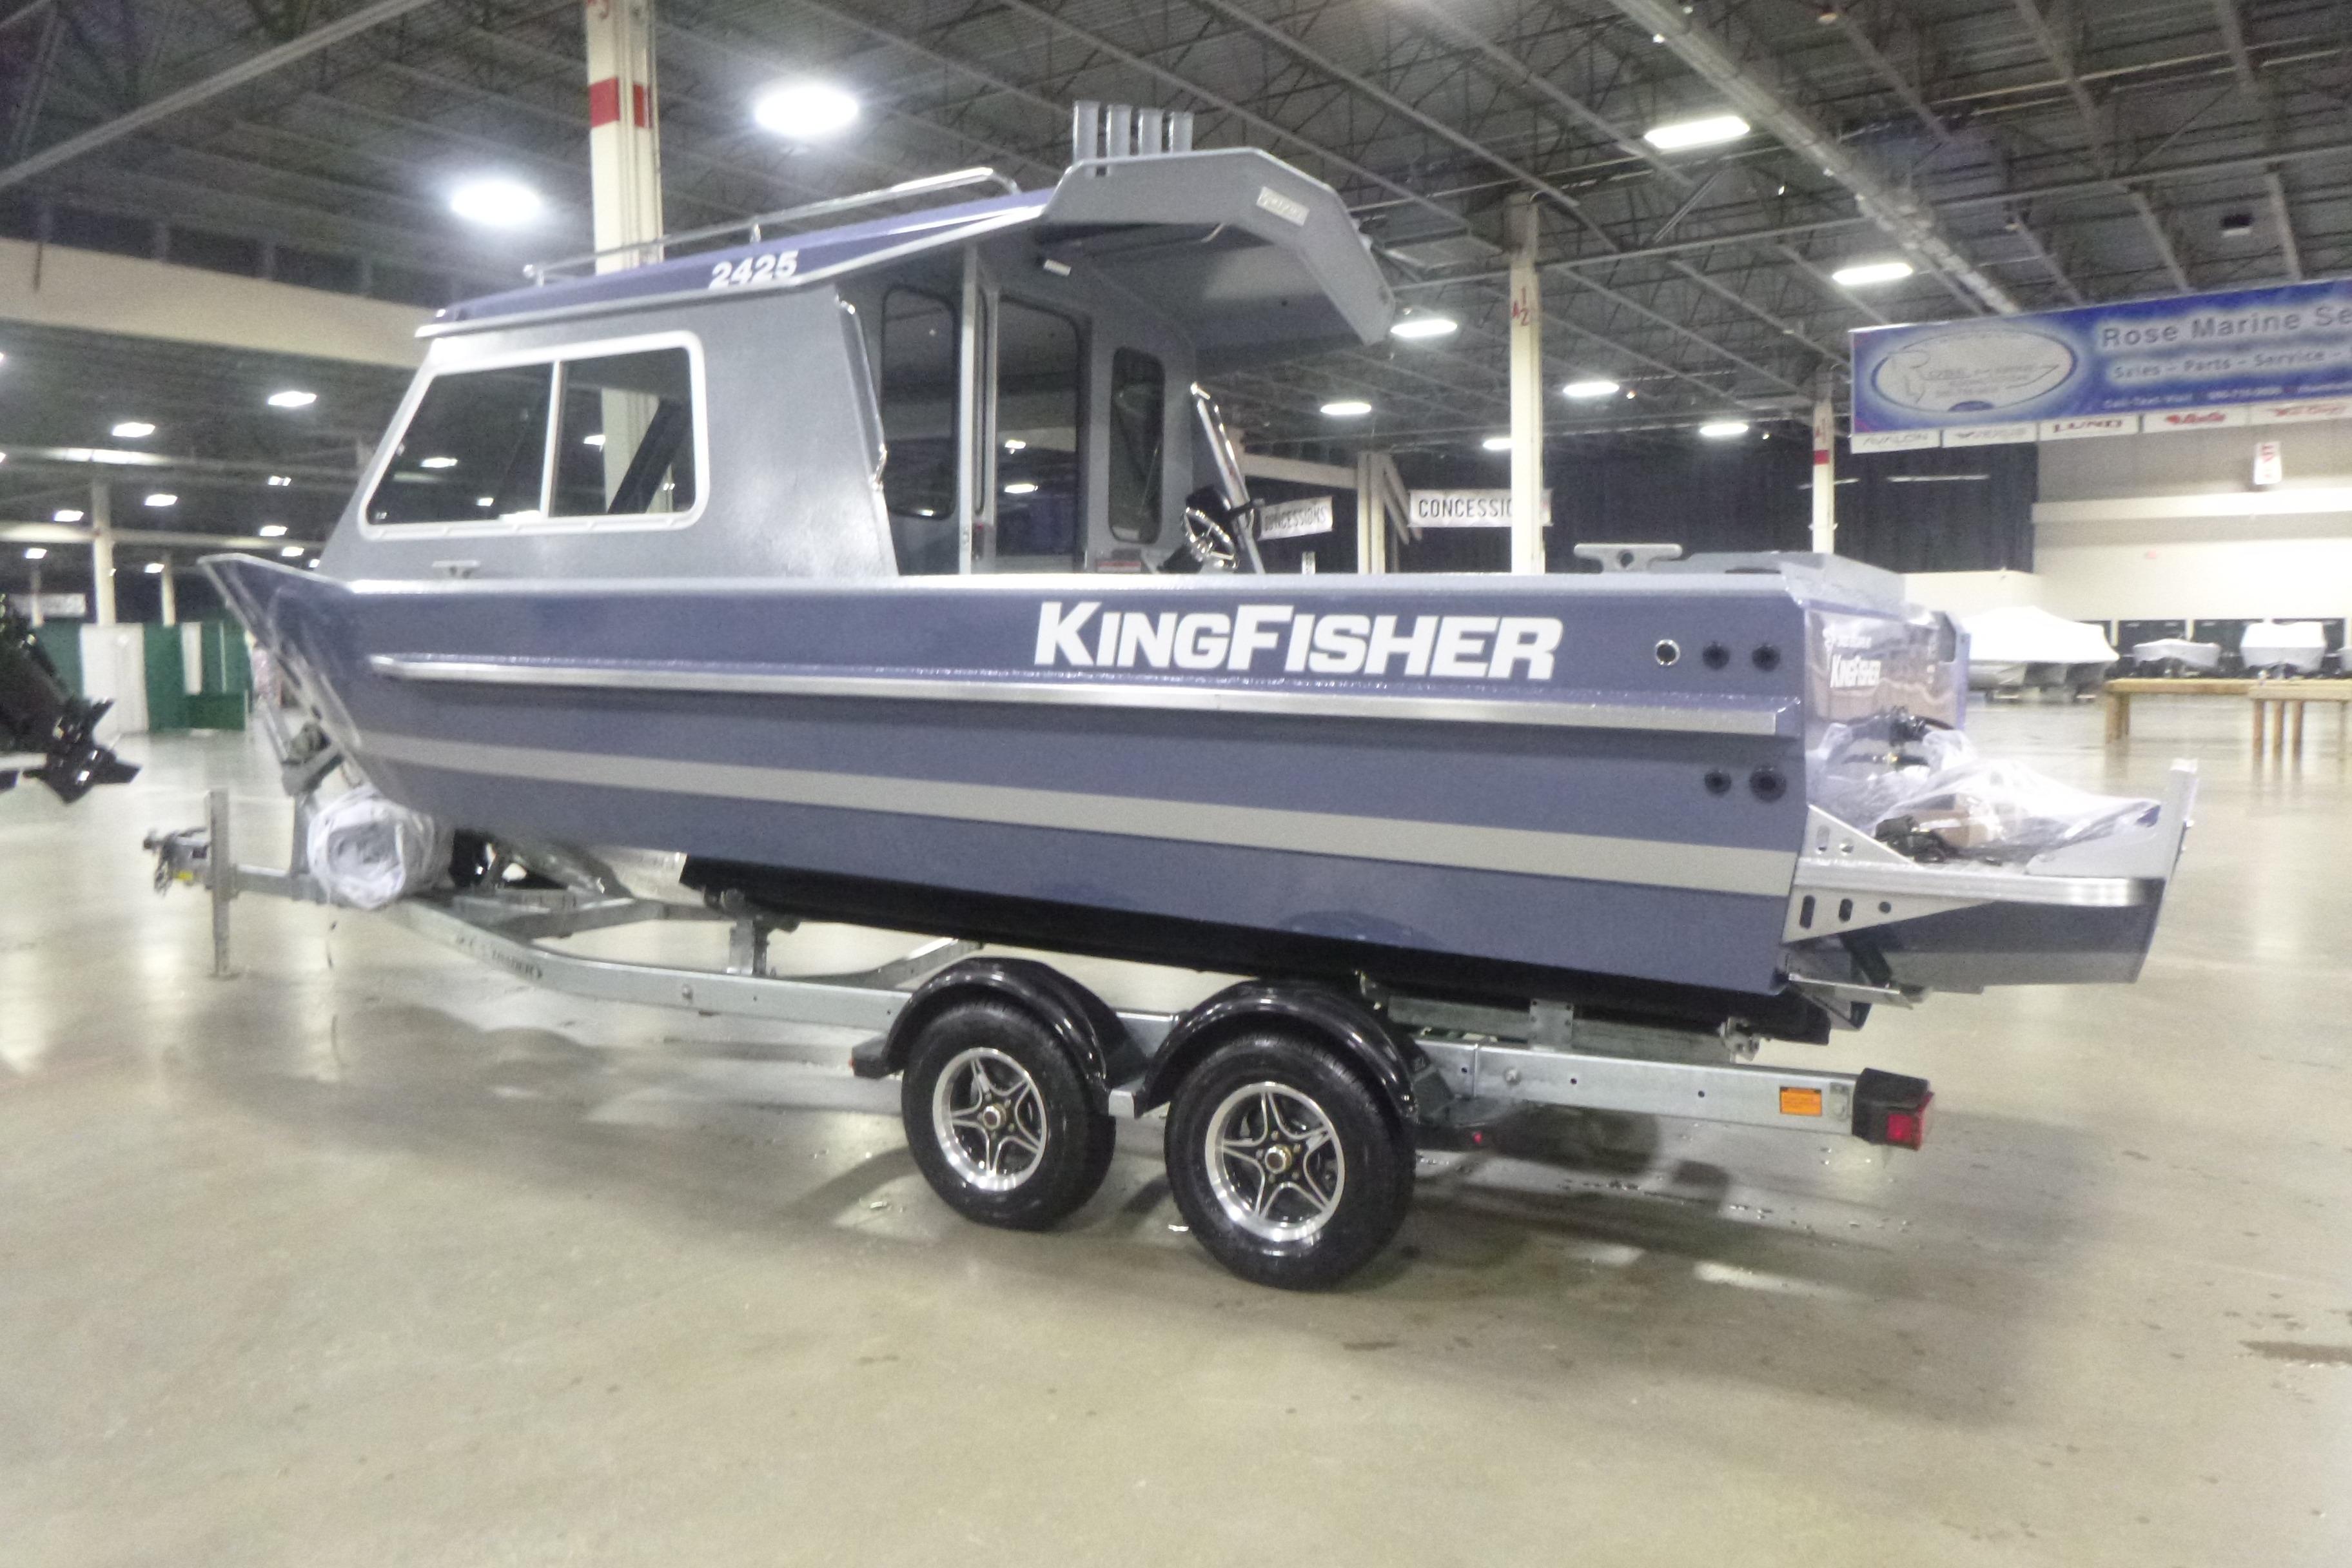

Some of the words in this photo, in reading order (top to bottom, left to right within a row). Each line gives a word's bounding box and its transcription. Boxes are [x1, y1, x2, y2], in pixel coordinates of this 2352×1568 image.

[709, 249, 799, 289] 2425
[2102, 324, 2179, 348] Rose
[2192, 312, 2302, 339] Marine
[2184, 358, 2231, 373] Parts
[2255, 349, 2325, 367] Service
[1034, 601, 1564, 681] KINGFISHER
